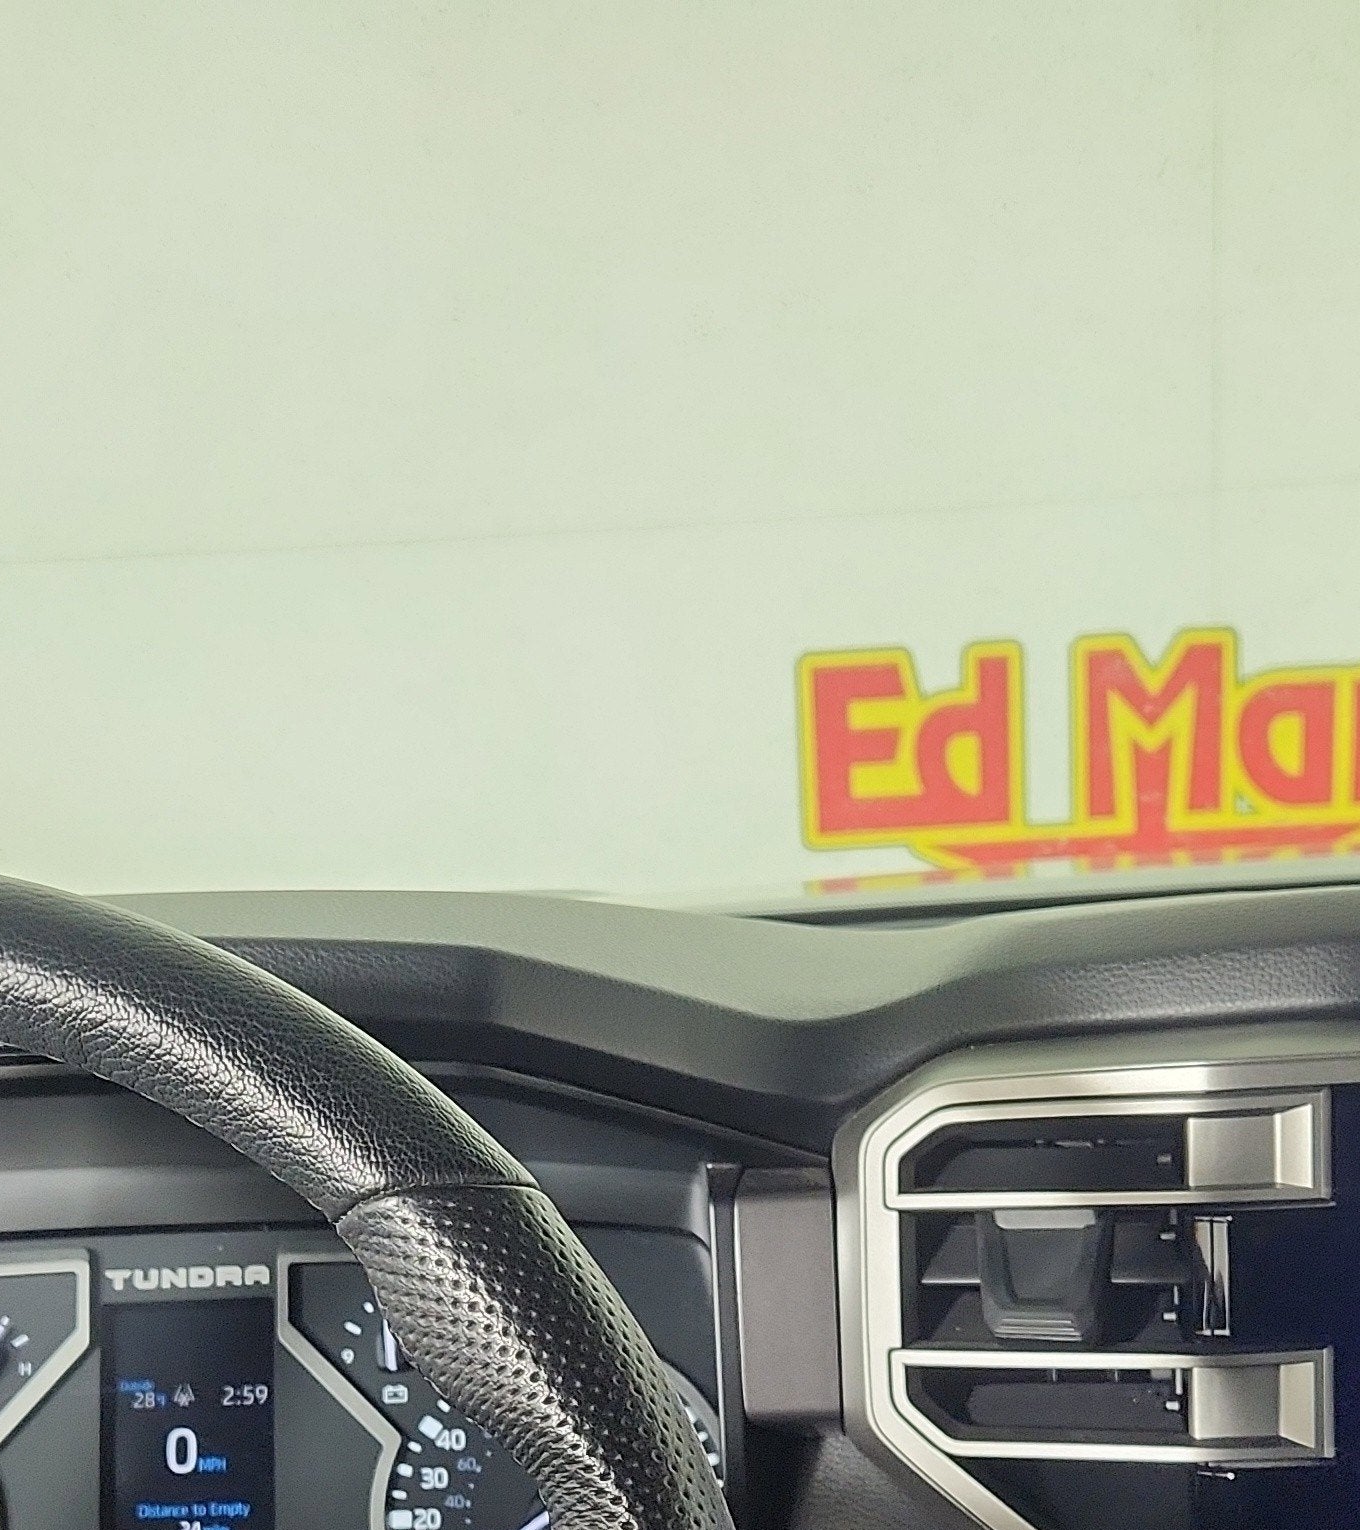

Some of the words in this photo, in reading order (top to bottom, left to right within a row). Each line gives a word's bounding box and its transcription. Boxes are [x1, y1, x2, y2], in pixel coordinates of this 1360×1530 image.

[812, 654, 1011, 834] Ed
[105, 1264, 270, 1291] TUNDRA
[18, 1361, 33, 1378] H
[132, 1392, 155, 1409] 28
[222, 1384, 269, 1407] 2:59
[165, 1427, 198, 1475] 0
[198, 1457, 227, 1473] MPH
[434, 1428, 466, 1451] 40
[419, 1467, 449, 1490] 30
[138, 1503, 189, 1518] Distance
[192, 1503, 207, 1517] to
[210, 1502, 251, 1518] Empty
[413, 1508, 442, 1530] 20
